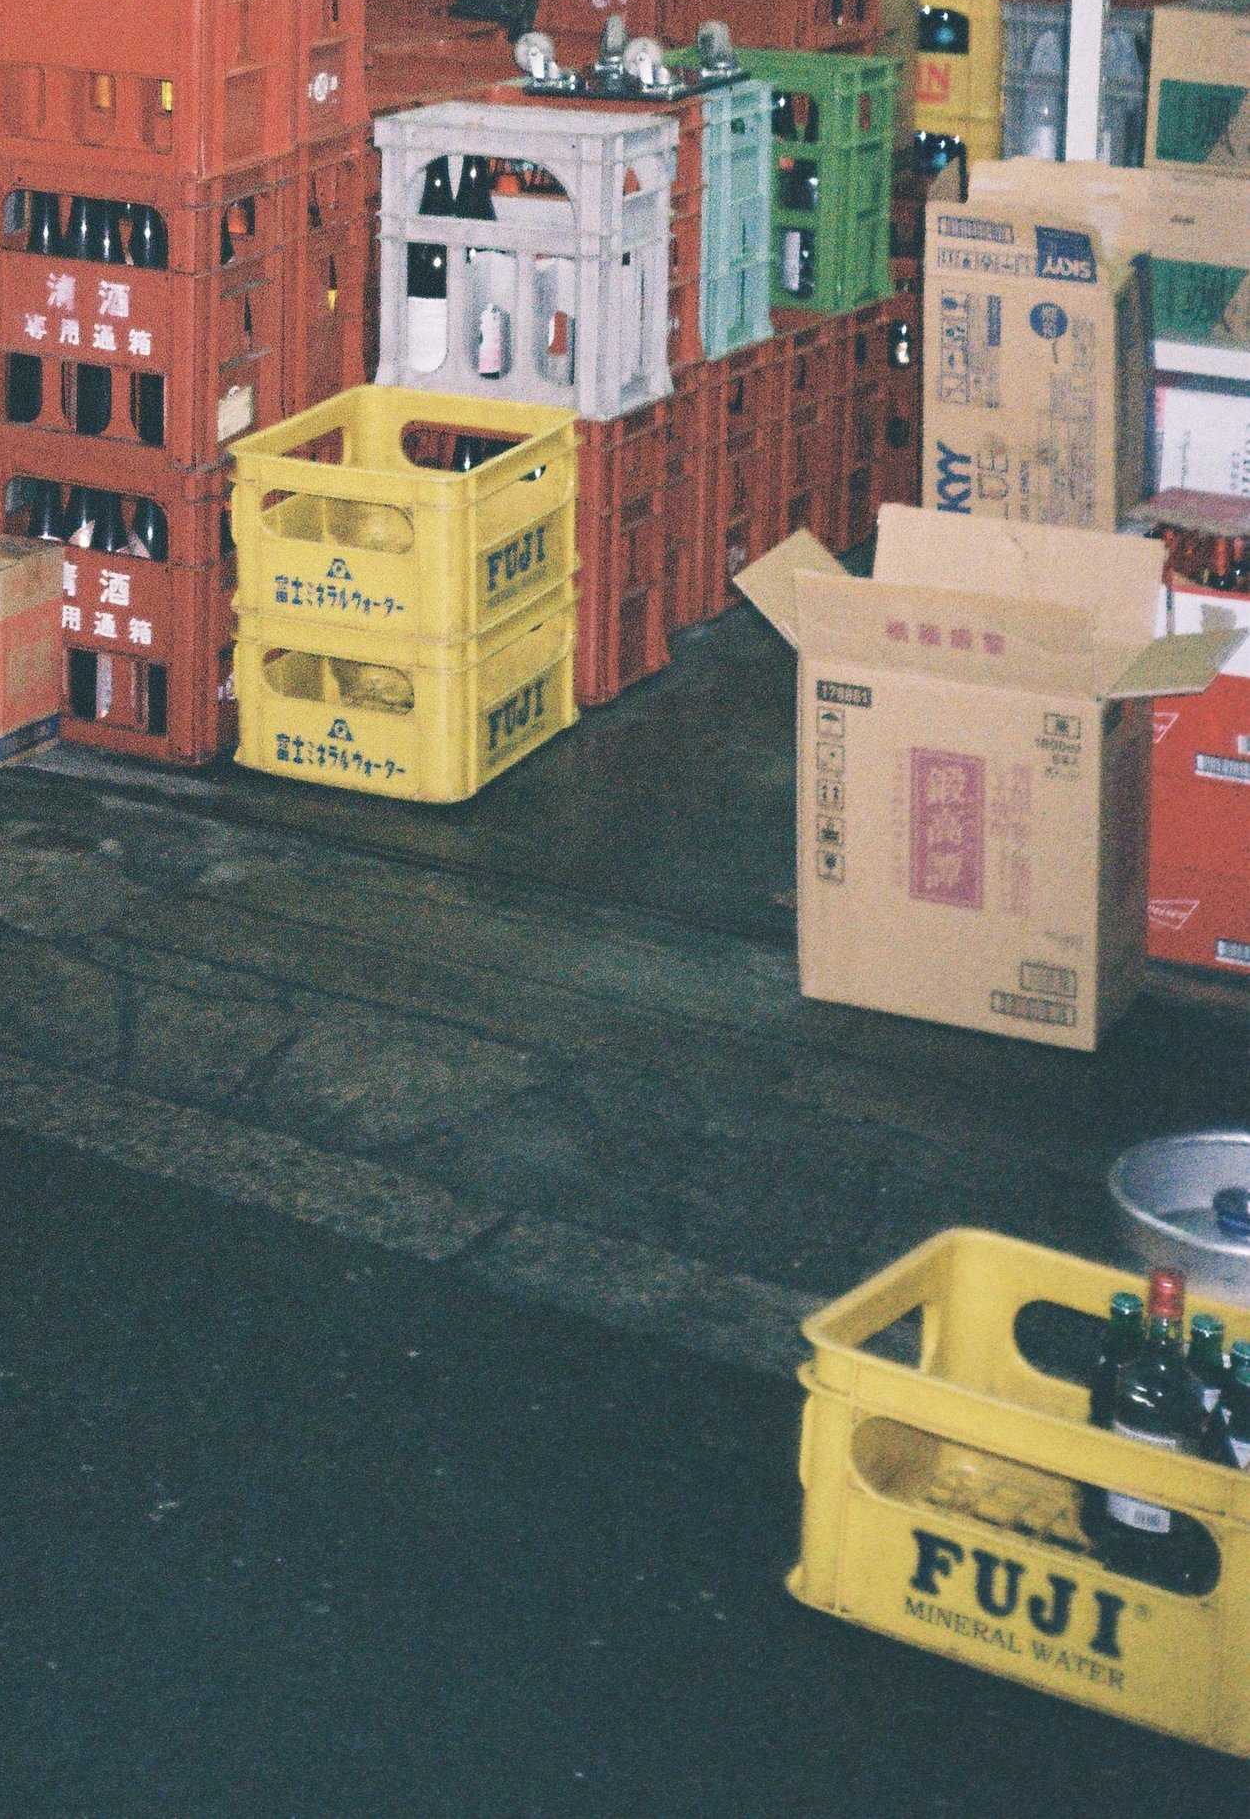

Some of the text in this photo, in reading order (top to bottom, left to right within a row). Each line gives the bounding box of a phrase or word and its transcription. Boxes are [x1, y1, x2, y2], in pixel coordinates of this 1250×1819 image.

[1041, 254, 1092, 279] SKYY
[46, 272, 130, 318] 清酒
[24, 314, 152, 356] 専用通箱
[936, 439, 972, 515] KYY
[487, 524, 548, 593] FUJI
[274, 574, 406, 616] 富士ミネラルウォーター
[61, 604, 153, 646] 用通箱
[488, 677, 546, 753] FUJI
[275, 732, 407, 779] 富士ミネラルウォーター
[909, 1527, 1128, 1659] FUJI
[904, 1595, 1126, 1693] MINERAL WATER
